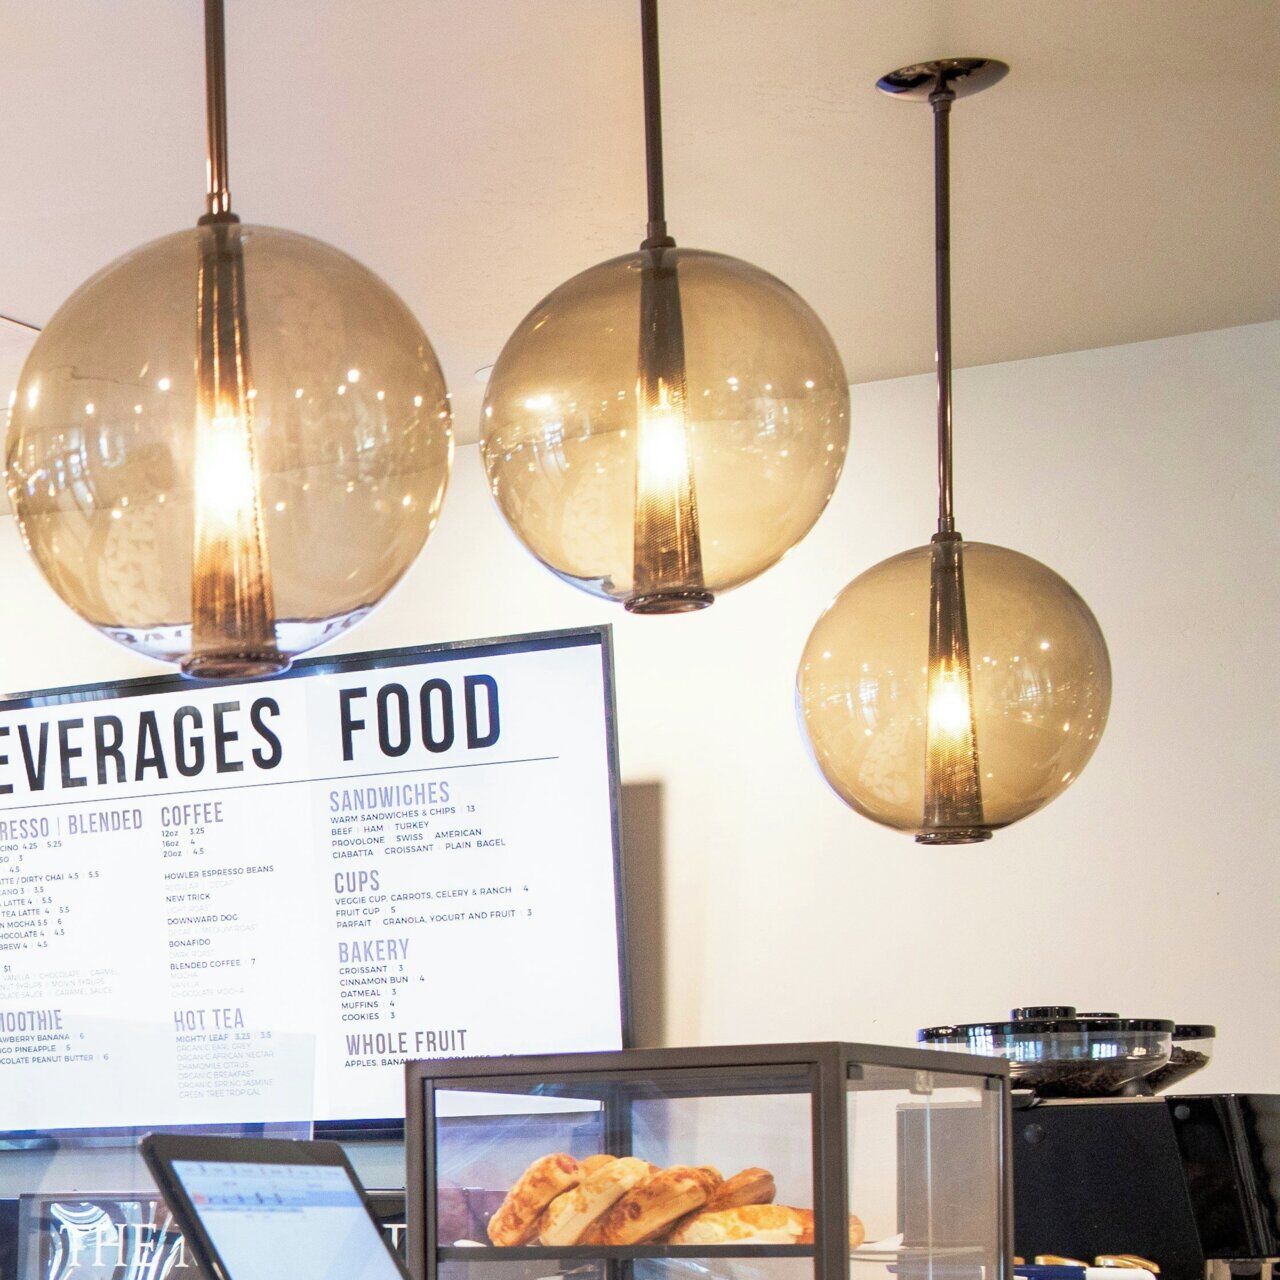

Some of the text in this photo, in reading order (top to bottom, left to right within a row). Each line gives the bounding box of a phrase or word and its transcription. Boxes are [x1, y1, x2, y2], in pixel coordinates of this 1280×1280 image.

[339, 673, 500, 761] FOOD
[330, 781, 448, 811] SANDWICHES
[161, 802, 222, 826] COFFEE
[330, 815, 358, 824] WARM
[360, 809, 418, 821] SANDWICHES
[429, 806, 455, 815] CHIPS
[466, 804, 475, 812] 13
[68, 809, 142, 834] BLENDED
[189, 826, 204, 835] 3.25
[331, 820, 429, 836] BEEF HAM TURKEY
[332, 828, 481, 846] PROVOLONE SWISS AMERICAN
[46, 840, 62, 848] 5.25
[332, 838, 505, 859] CIABATTA CROISSANT PLAIN BAGEL
[9, 865, 20, 873] 4.5
[164, 865, 274, 880] HOWLER ESPRESSO BEANS
[20, 875, 43, 883] DIRTY
[88, 870, 99, 878] 5.5
[334, 870, 379, 893] CUPS
[334, 896, 366, 905] VEGGIE
[368, 894, 388, 903] CUP,
[390, 891, 433, 901] CARROTS,
[435, 889, 468, 898] CELERY
[479, 886, 511, 895] RANCH
[523, 884, 528, 892] 4
[3, 898, 25, 906] LATTE
[42, 896, 52, 904] 5.5
[18, 908, 40, 916] LATTE
[335, 905, 396, 917] FRUIT CUP 5
[6, 920, 35, 928] MOCHA
[37, 918, 47, 926] 5.5
[167, 913, 238, 925] DOWNWARD DOG
[336, 908, 532, 928] PARFAIT GRANOLA, YOGURT AND FRUIT 3
[37, 940, 47, 948] 4.5
[168, 938, 210, 947] BONAFIDO
[339, 938, 408, 963] BAKERY
[3, 964, 11, 973] $1
[170, 961, 207, 970] BLENDED
[209, 959, 240, 967] COFFEE
[339, 964, 403, 974] CROISSANT 3
[339, 977, 387, 986] CINNAMON
[340, 989, 380, 998] OATMEAL
[341, 1000, 378, 1009] MUFFINS
[174, 1008, 244, 1031] HOT TEA
[341, 1011, 395, 1021] COOKIES 3
[36, 1033, 70, 1041] BANANA
[176, 1034, 206, 1042] MIGHTY
[208, 1033, 228, 1041] LEAF
[234, 1032, 250, 1040] 3.25
[346, 1029, 466, 1055] WHOLE FRUIT
[14, 1044, 56, 1053] PINEAPPLE
[32, 1055, 61, 1063] PEANUT
[64, 1054, 93, 1062] BUTTER
[344, 1058, 423, 1067] APPLES, BANA
[60, 1223, 157, 1267] THE
